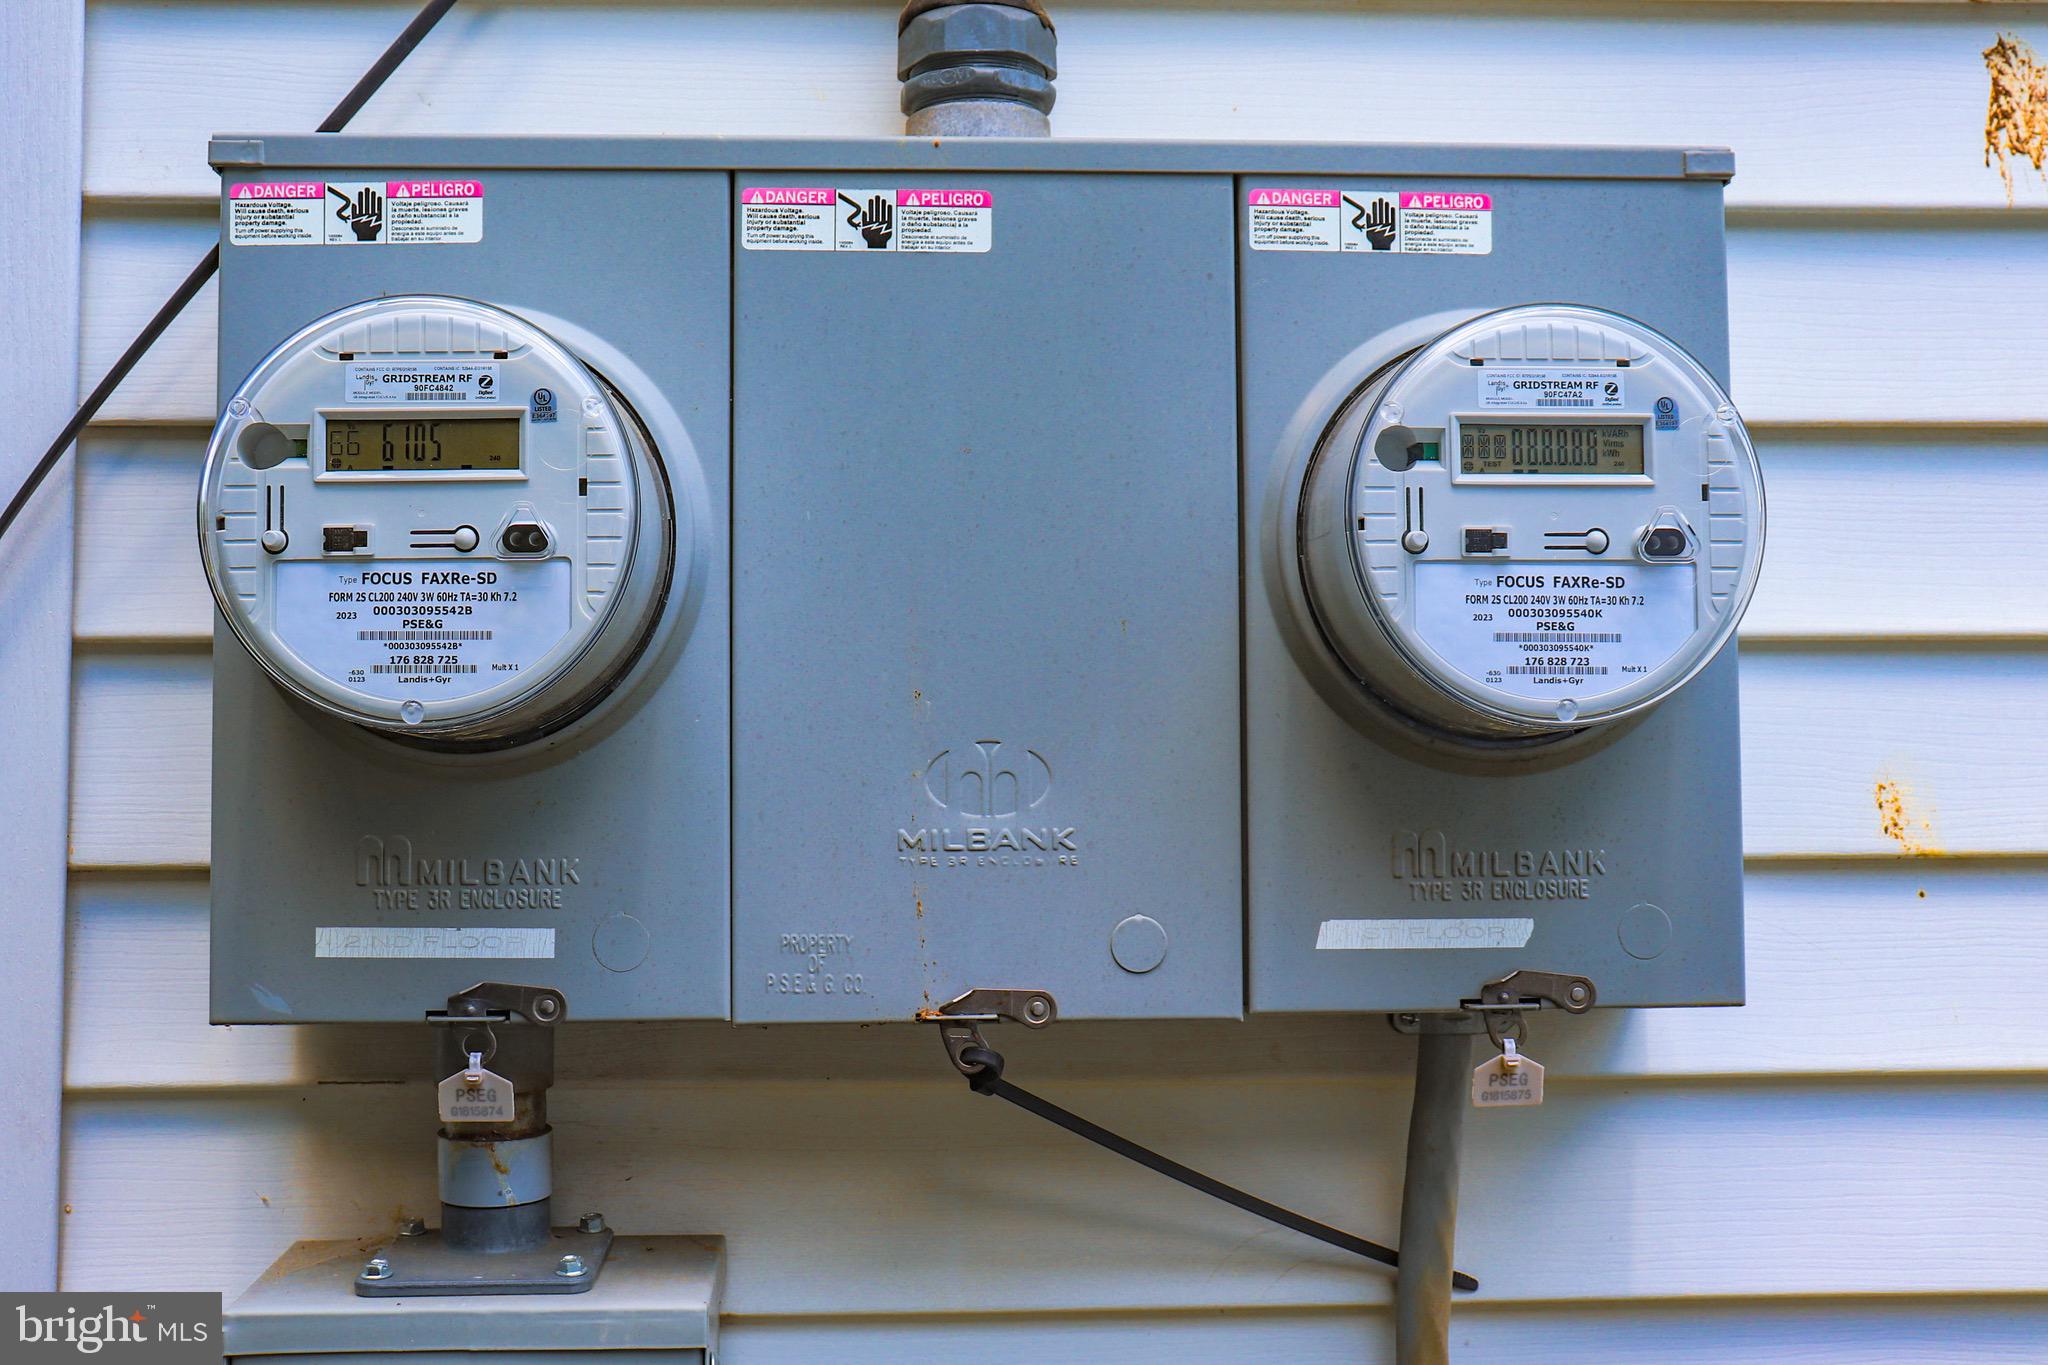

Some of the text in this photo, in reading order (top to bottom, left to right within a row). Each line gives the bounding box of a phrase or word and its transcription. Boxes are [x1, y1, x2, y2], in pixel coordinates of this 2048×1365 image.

[254, 186, 316, 198] DANGER
[412, 184, 474, 196] PELIGRO
[766, 191, 827, 203] DANGER
[922, 193, 983, 206] PELIGRO
[1272, 192, 1332, 204] DANGER
[1424, 196, 1484, 208] PELIGRO
[383, 375, 456, 383] GRIDSTREAM
[1513, 381, 1599, 390] GRIDSTREAM RF
[538, 392, 547, 401] UL
[1660, 401, 1669, 410] UL
[383, 424, 441, 461] 6105
[339, 572, 497, 585] Type FOCUS FAXRe-SD
[1474, 576, 1625, 588] Type FOCUS FAXRe-SD
[329, 592, 517, 602] FORM 2S CL200 240V 3W 60Hz TA=30 Kh 7.2
[1466, 595, 1644, 605] FORM 2S CL200 240V 3W 60Hz TA=30 Kh 7.2
[373, 606, 472, 615] 000303095542B
[1508, 608, 1603, 618] 000303095540K
[403, 620, 442, 628] PSE&G
[1536, 622, 1575, 631] PSE&G
[390, 655, 458, 664] 176 828 725
[1525, 657, 1590, 666] 176 828 723
[897, 827, 1077, 852] MILBANK
[949, 857, 967, 866] 3R
[1451, 849, 1607, 877] MILBANK
[417, 858, 580, 886] MILBANK
[1410, 878, 1590, 901] TYPE 3R ENCLOSURE
[374, 889, 562, 909] TYPE 3R ENCLOSURE
[1408, 926, 1505, 940] FLOOR
[780, 933, 854, 954] PROPERTY
[807, 953, 828, 975] OF
[1489, 1073, 1528, 1086] PSEG
[456, 1088, 496, 1102] PSEG
